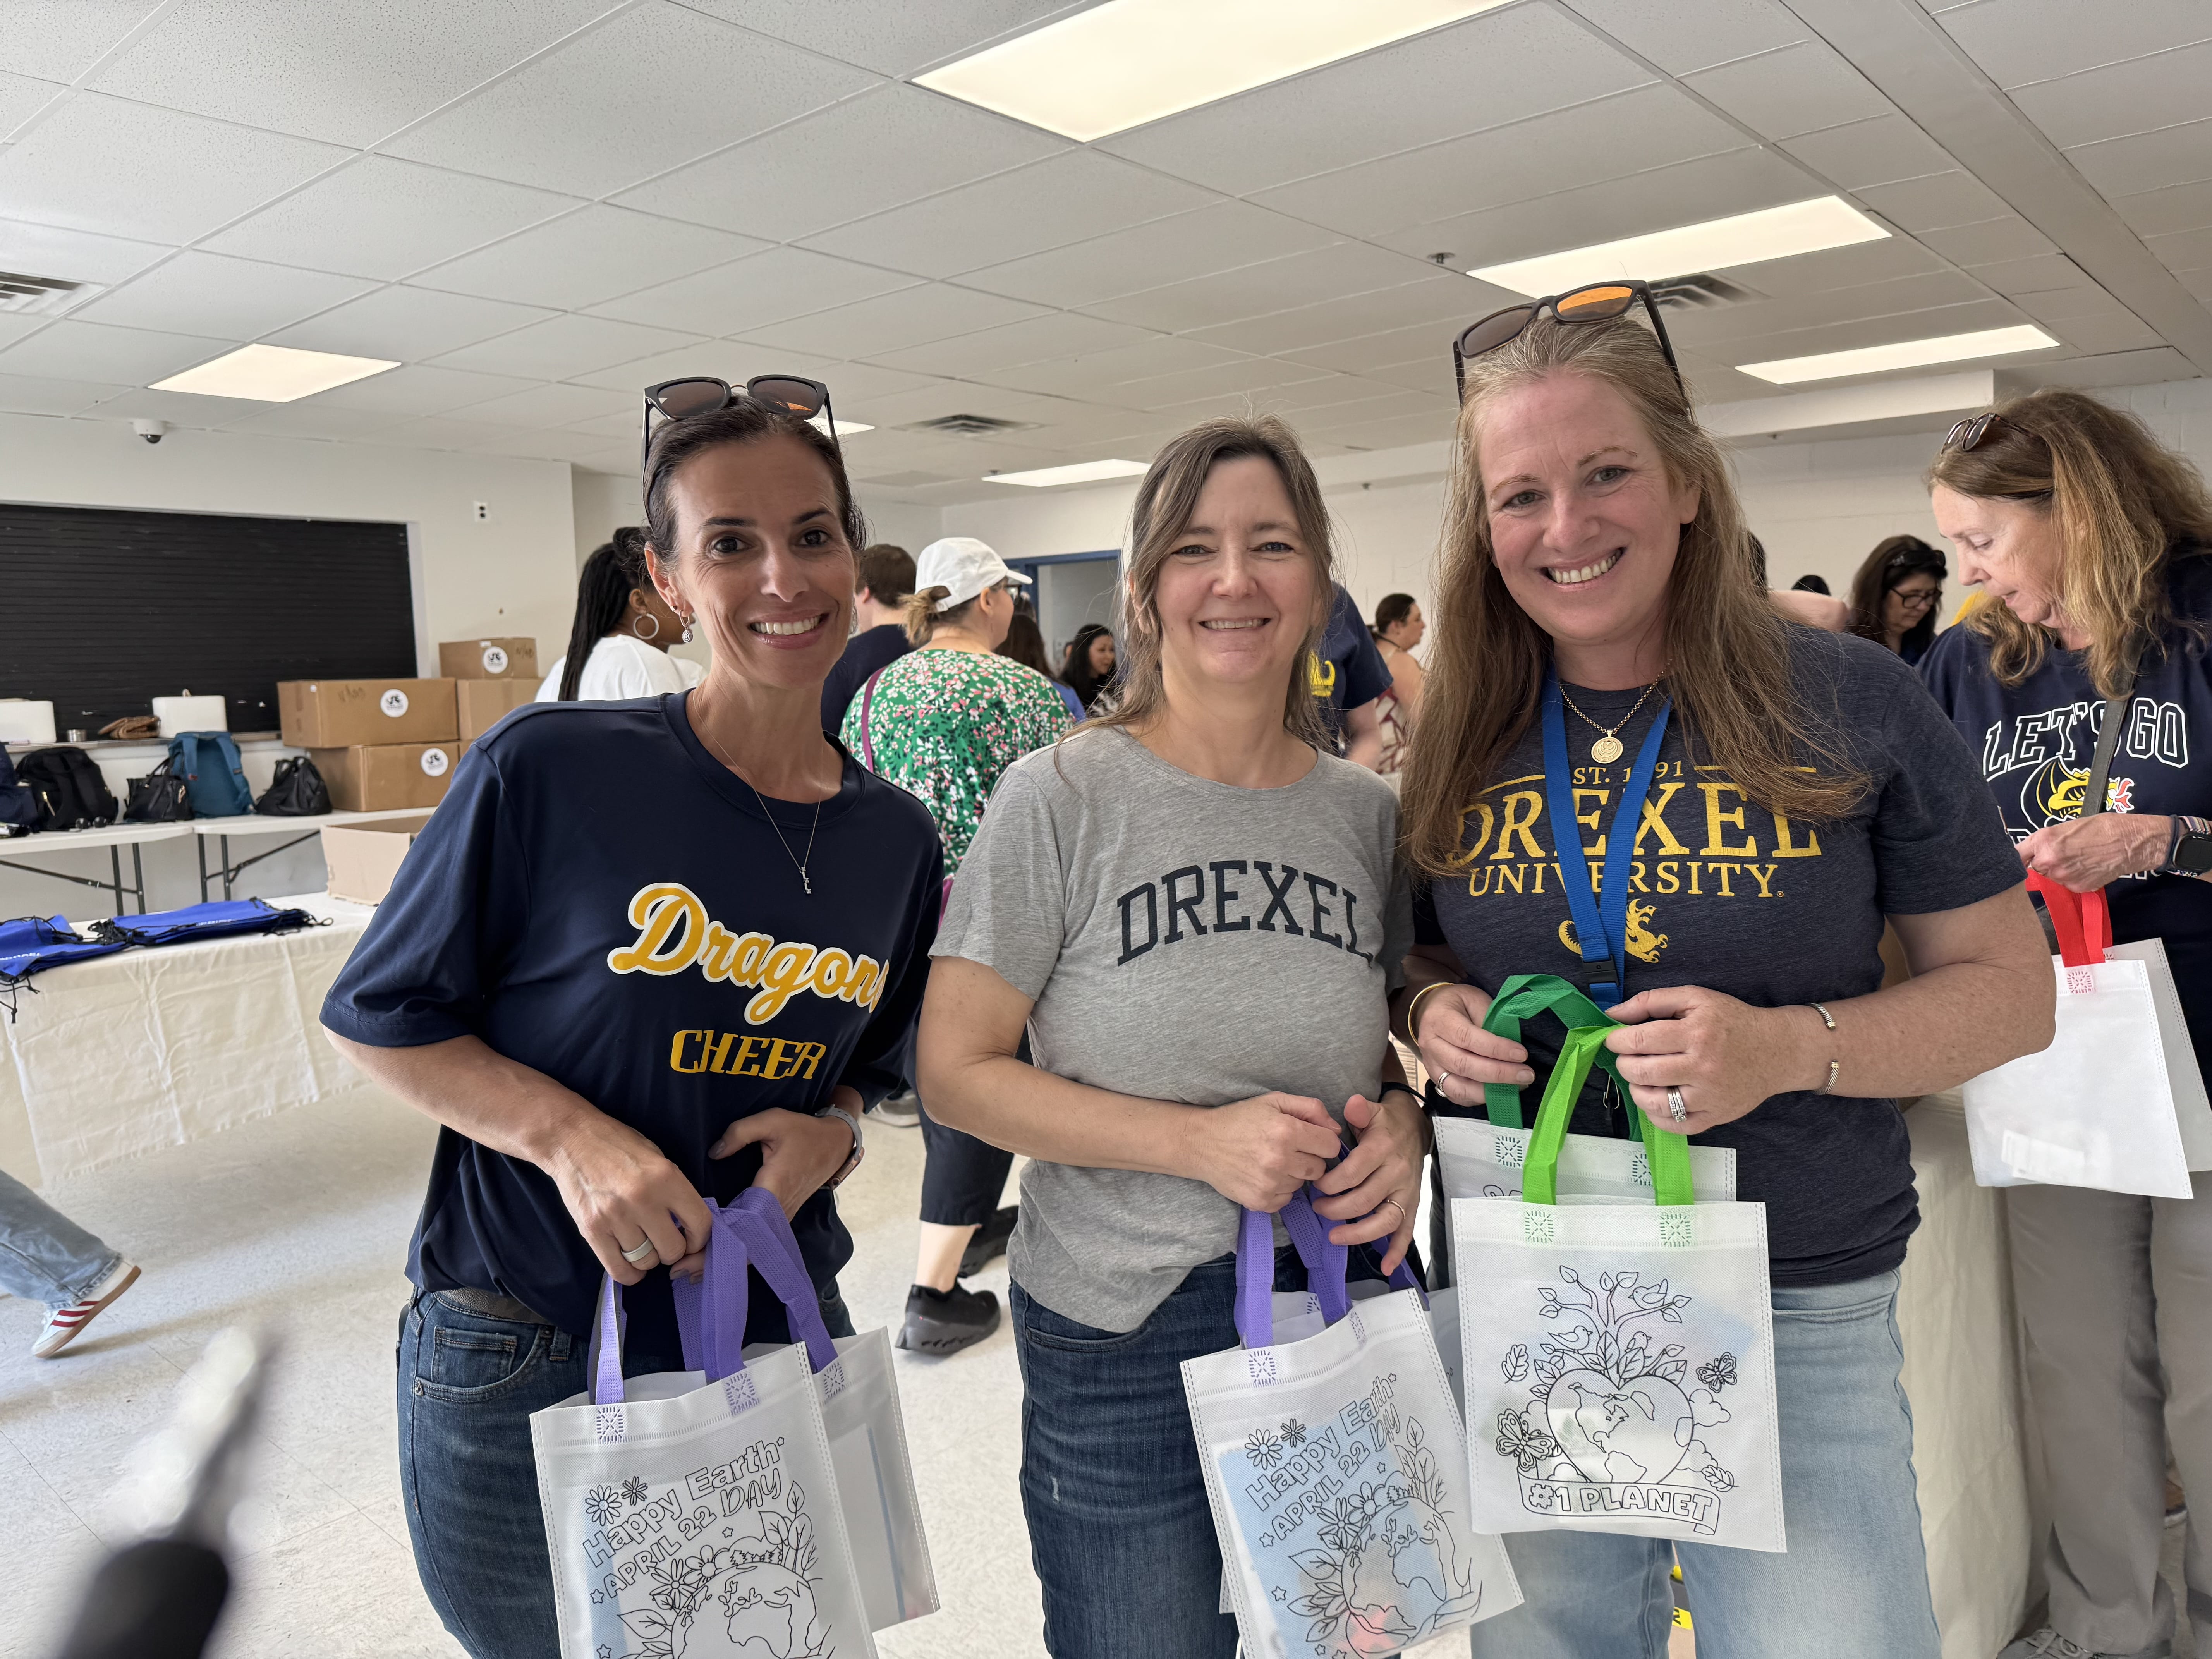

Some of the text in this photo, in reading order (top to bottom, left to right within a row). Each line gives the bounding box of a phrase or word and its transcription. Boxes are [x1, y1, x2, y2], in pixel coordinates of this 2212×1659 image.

[1572, 760, 1683, 785] ST. 191
[2126, 697, 2188, 768] GO
[1118, 860, 1373, 968] DREXEL
[671, 1029, 827, 1079] CHEER
[1245, 1376, 1394, 1511] Happy Earth
[1272, 1403, 1400, 1540] APRIL 22 DAY
[582, 1440, 780, 1567] Happy Earth
[603, 1468, 781, 1598] APRIL 22 DAY
[1528, 1483, 1713, 1521] #1 PLANET
